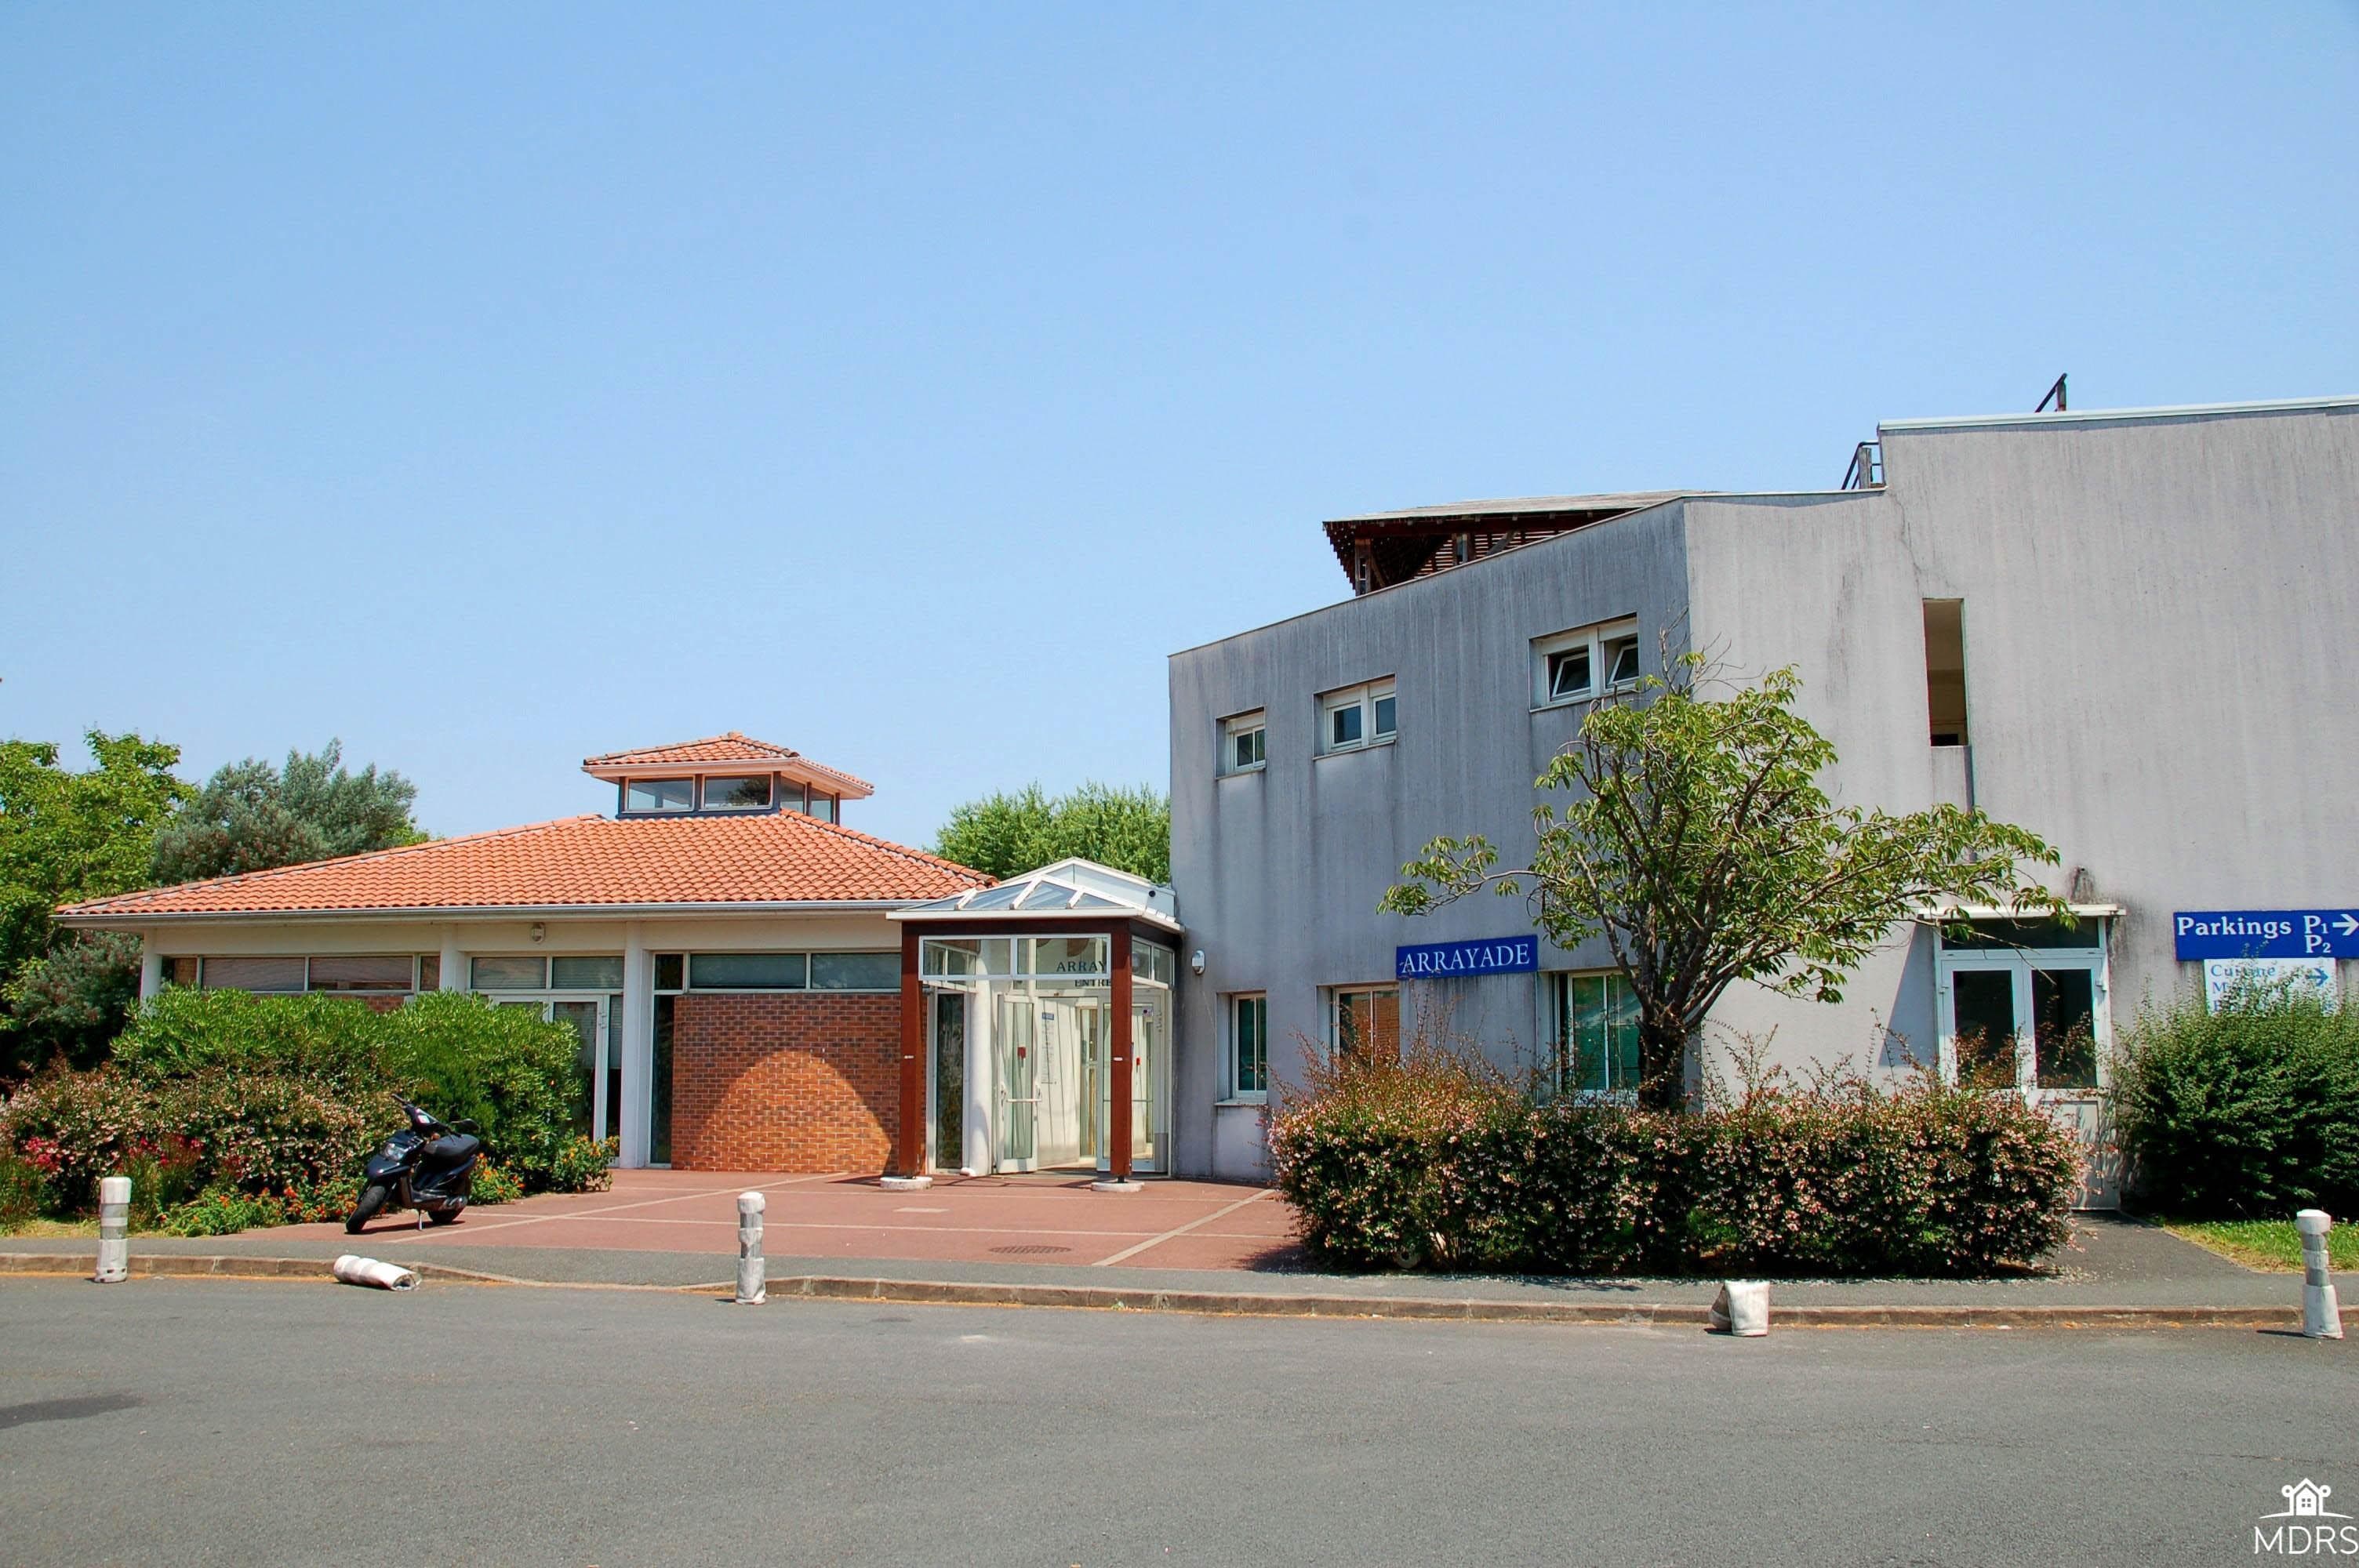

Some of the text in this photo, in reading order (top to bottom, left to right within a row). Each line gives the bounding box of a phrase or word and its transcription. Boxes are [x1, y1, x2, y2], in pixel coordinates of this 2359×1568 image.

[2176, 916, 2292, 939] Parkings
[2305, 935, 2332, 953] P2
[1401, 943, 1530, 974] ARRAYADE
